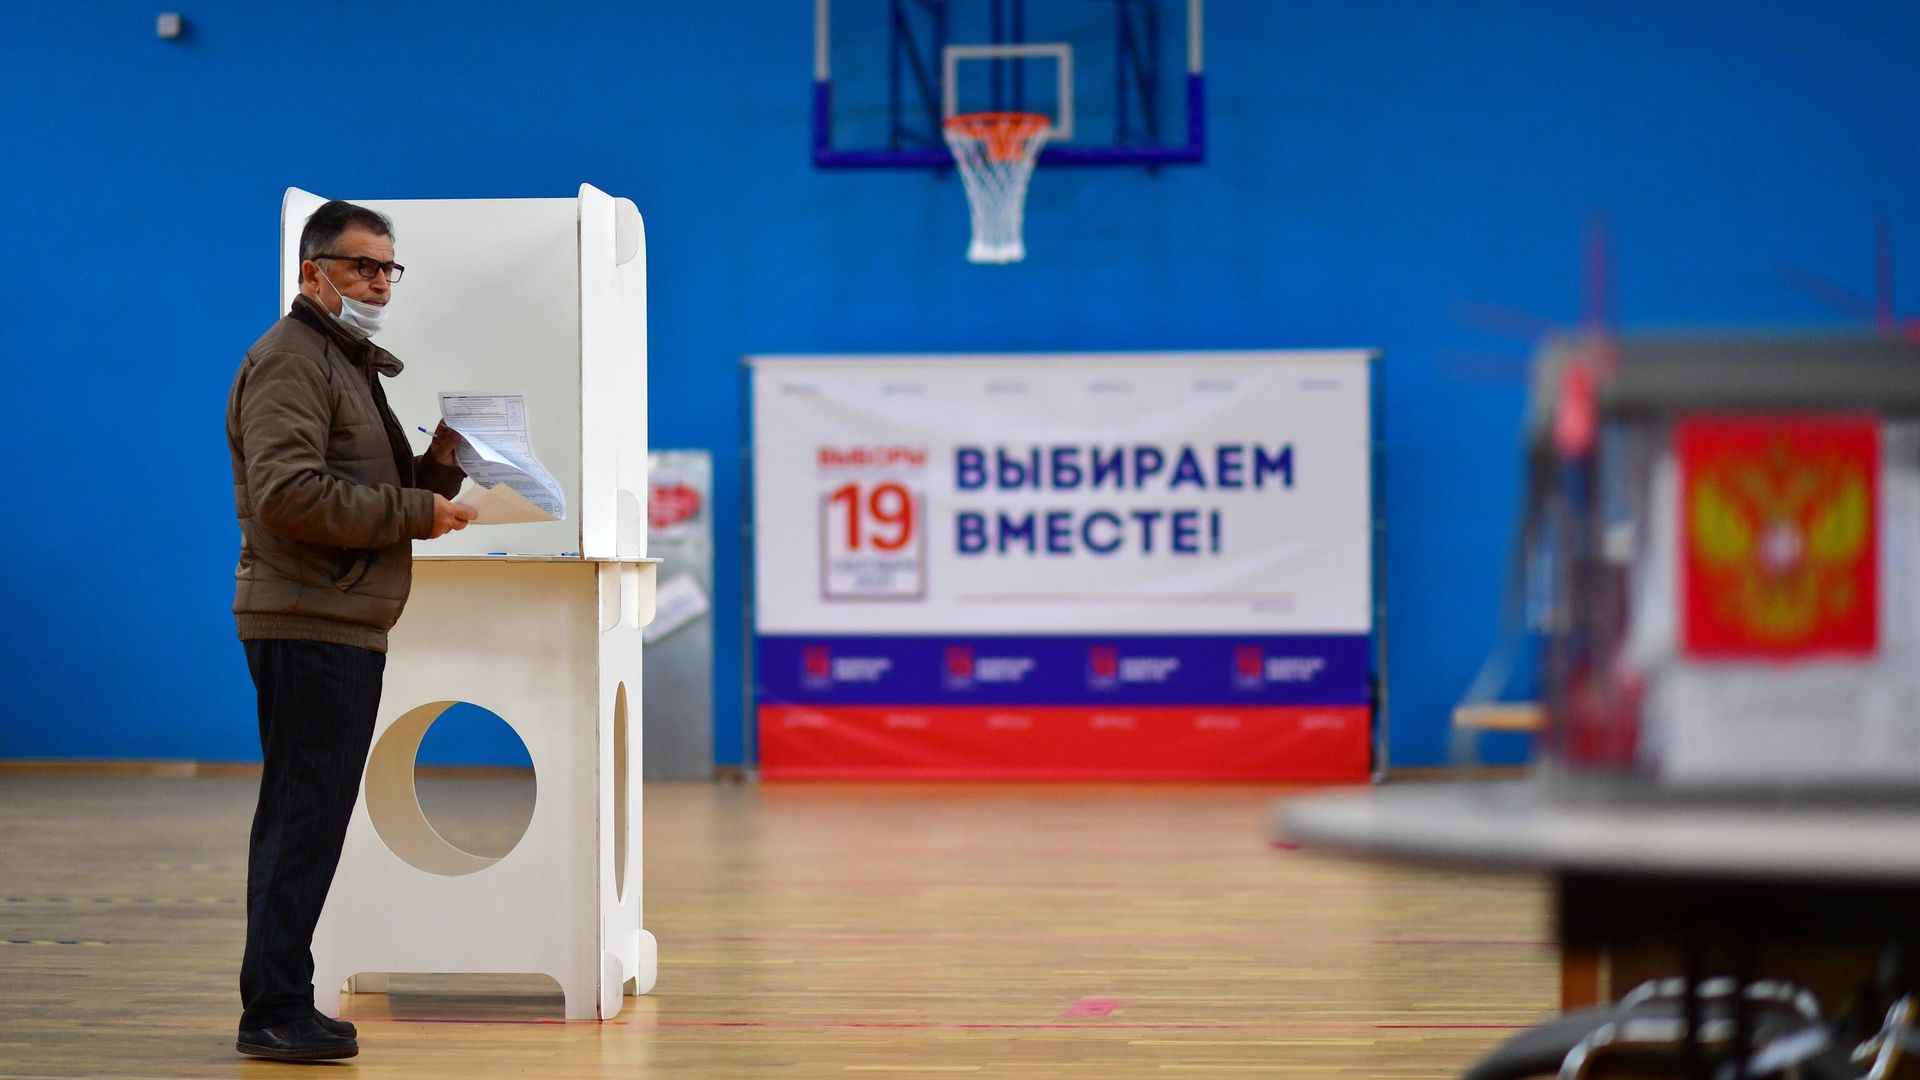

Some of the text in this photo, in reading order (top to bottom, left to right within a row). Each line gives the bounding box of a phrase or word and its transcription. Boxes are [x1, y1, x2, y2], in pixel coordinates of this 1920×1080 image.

[955, 443, 1294, 491] ВЫБИРАЕМ
[831, 482, 912, 552] 19
[955, 510, 1222, 555] ВМЕСТЕ!
